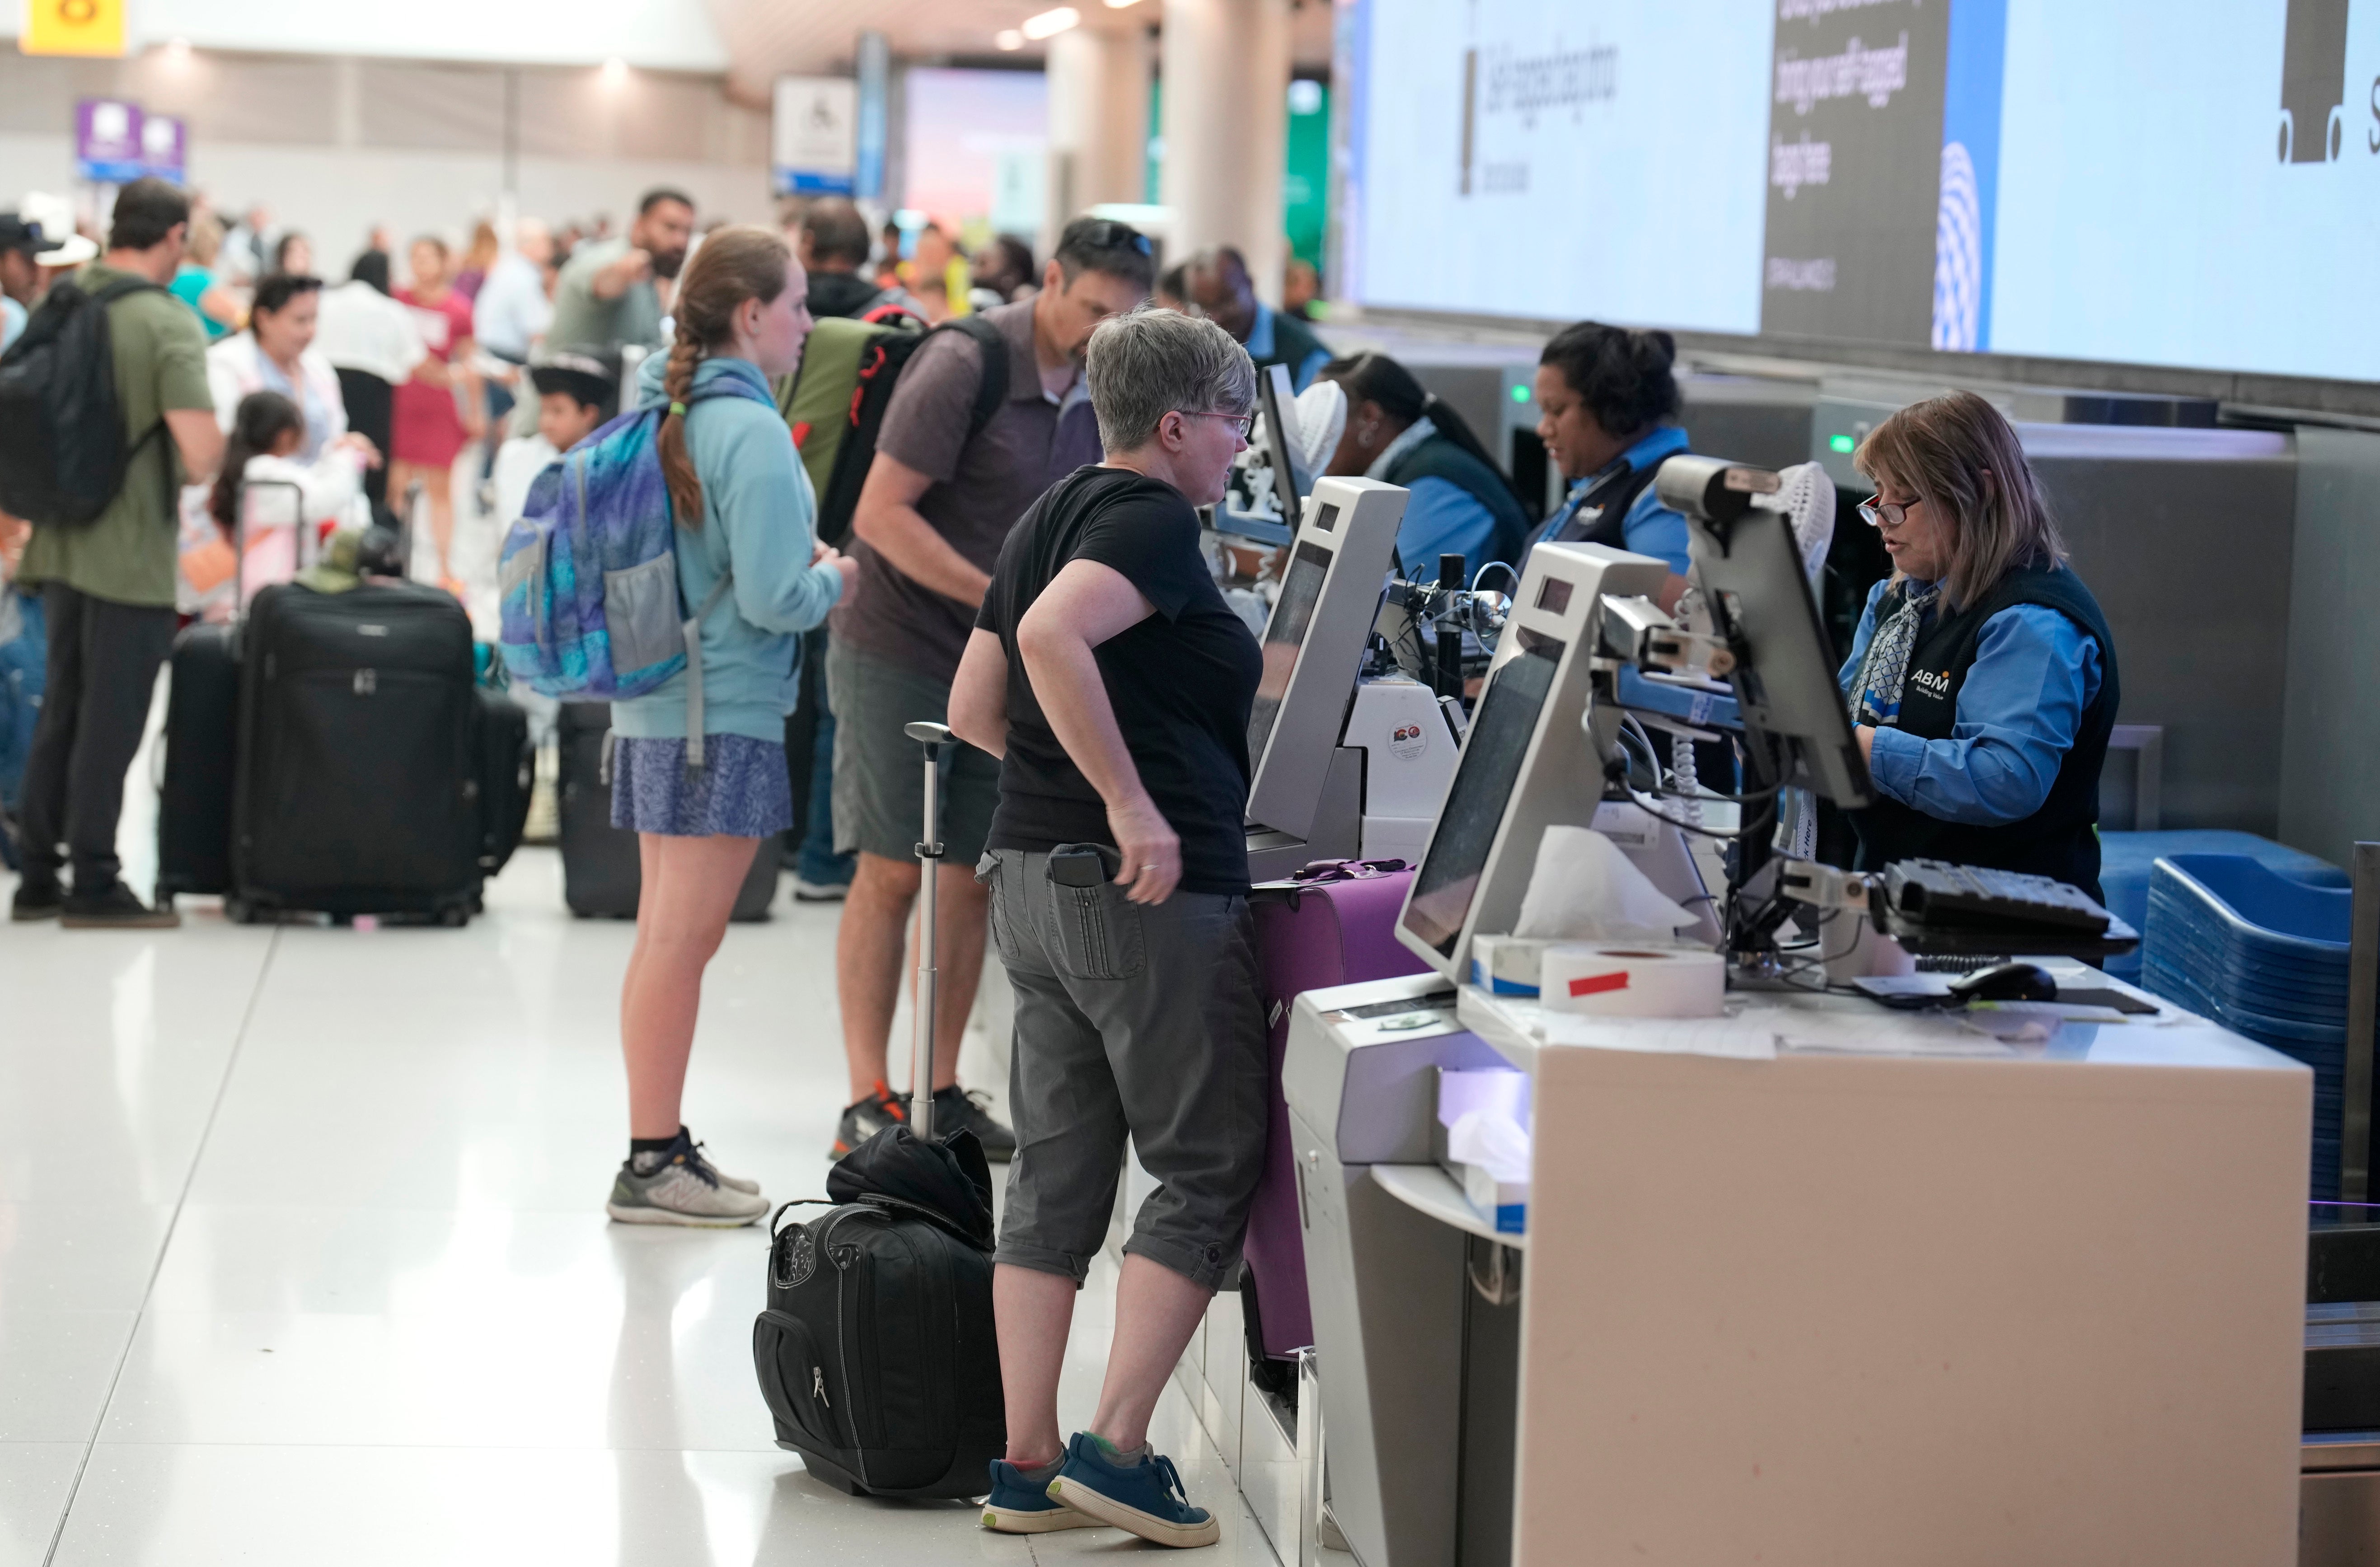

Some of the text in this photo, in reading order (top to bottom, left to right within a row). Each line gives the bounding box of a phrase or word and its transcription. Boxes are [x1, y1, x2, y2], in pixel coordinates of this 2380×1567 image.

[1911, 669, 1949, 692] ABM
[1916, 685, 1944, 700] Building Value
